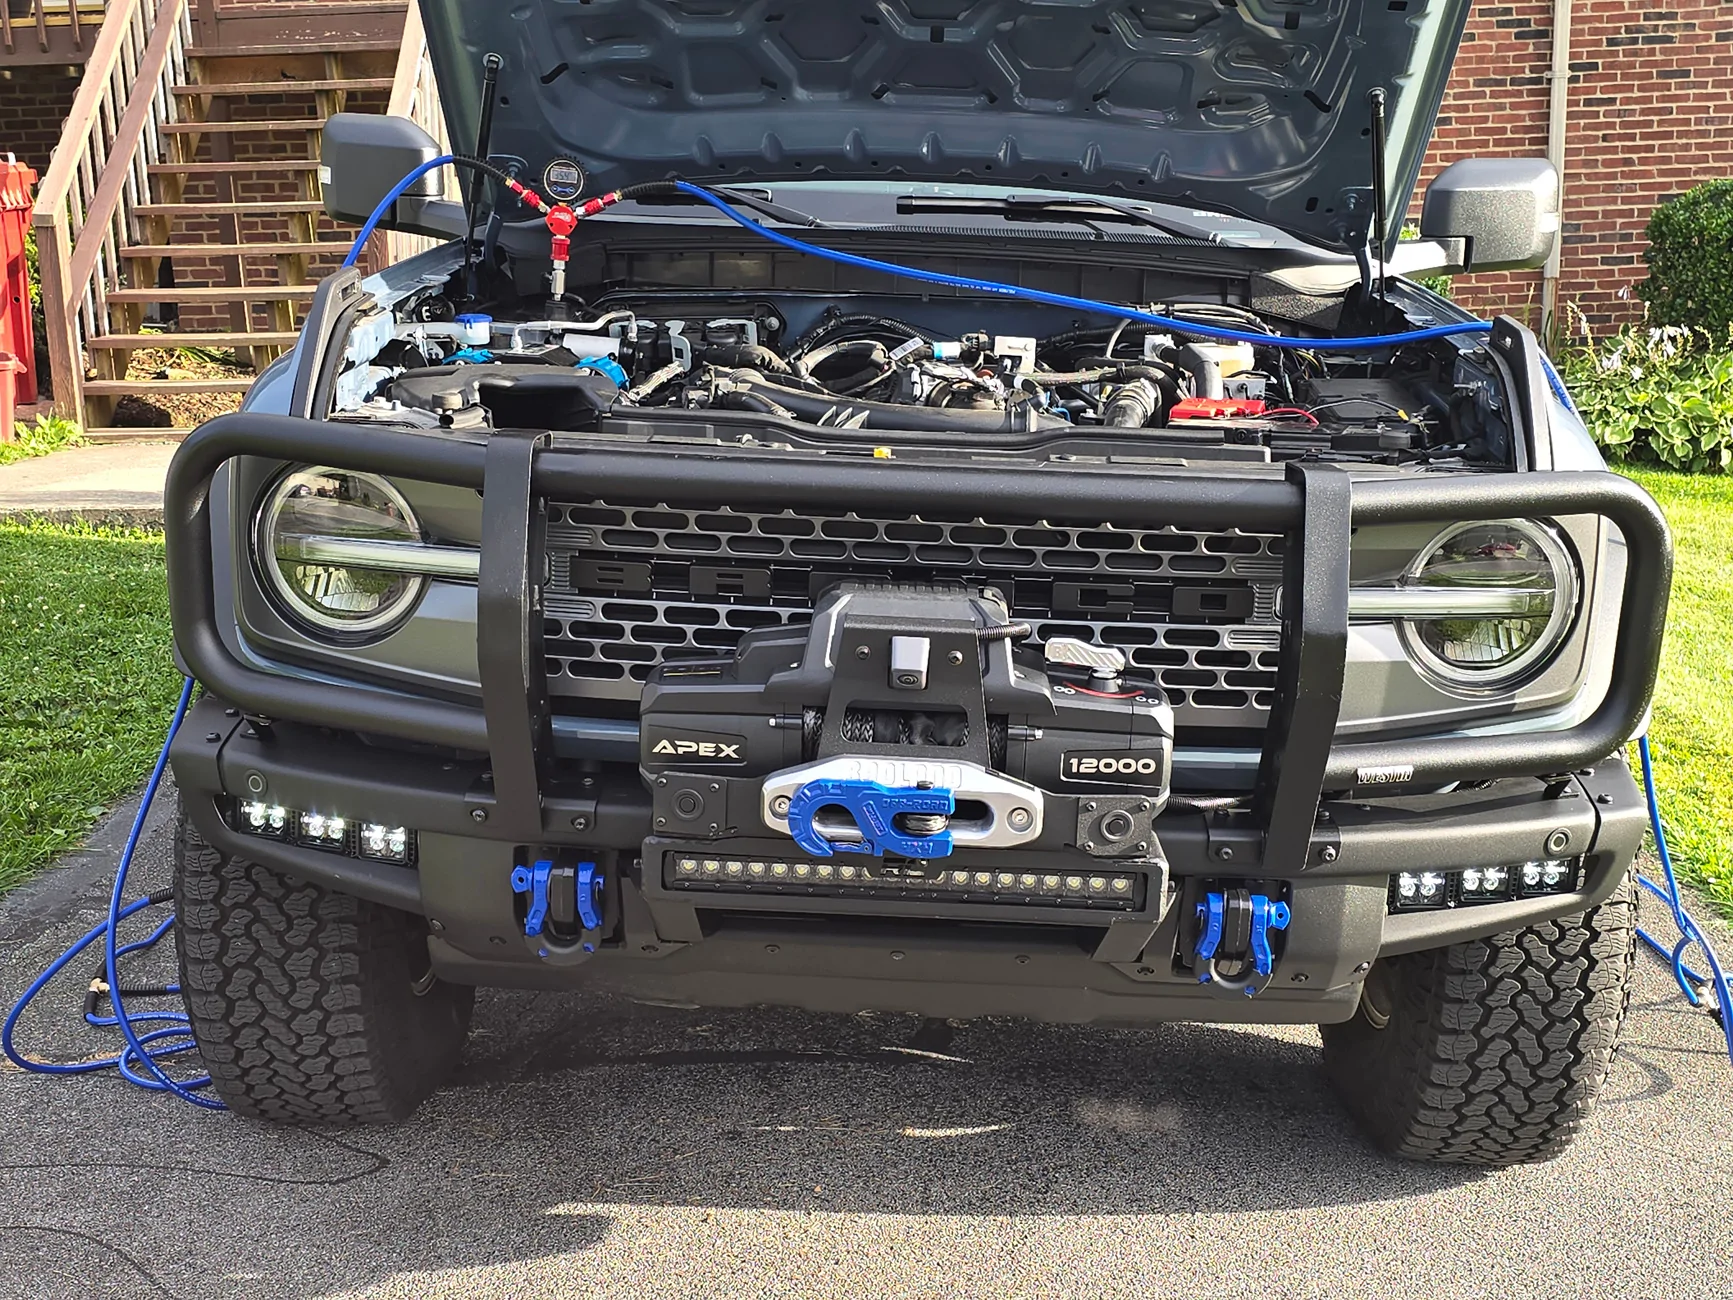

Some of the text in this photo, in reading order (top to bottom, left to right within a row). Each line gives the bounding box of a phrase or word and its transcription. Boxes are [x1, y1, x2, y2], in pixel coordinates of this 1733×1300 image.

[569, 556, 1255, 618] BRCO
[652, 739, 739, 759] APEX
[1069, 758, 1156, 774] 12000
